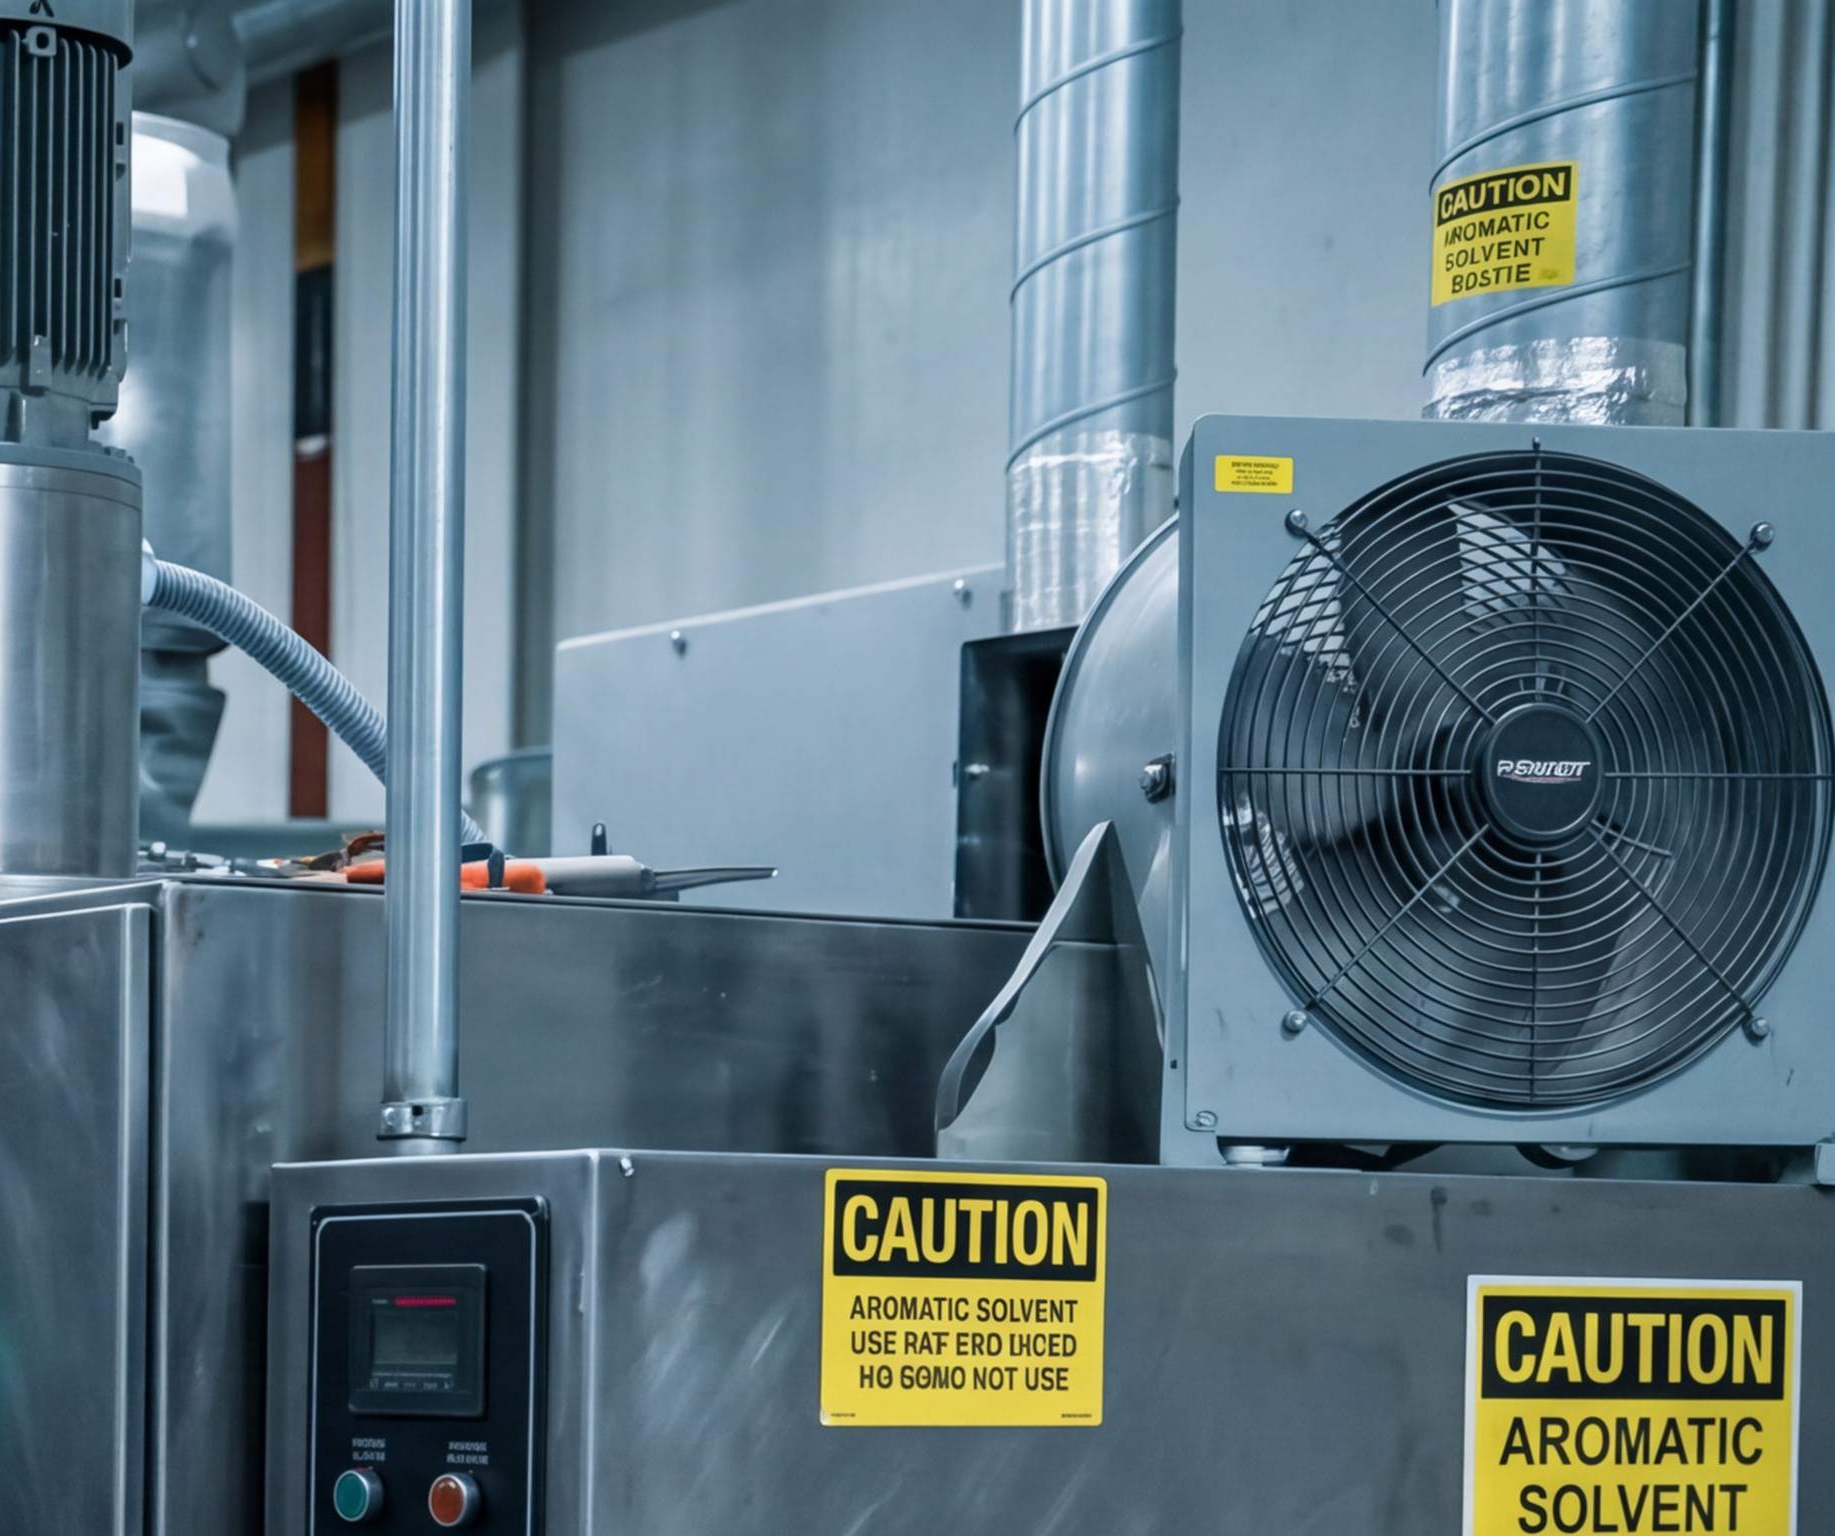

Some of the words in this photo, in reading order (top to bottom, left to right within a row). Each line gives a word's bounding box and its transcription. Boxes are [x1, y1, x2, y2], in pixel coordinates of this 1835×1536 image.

[1440, 172, 1566, 221] CAUTION
[841, 1194, 1089, 1266] CAUTION
[849, 1295, 970, 1322] AROMATIC
[976, 1297, 1079, 1323] SOLVENT
[851, 1330, 898, 1356] USE
[1494, 1310, 1774, 1385] CAUTION
[972, 1366, 1019, 1391] NOT
[1024, 1367, 1070, 1392] USE
[1498, 1416, 1764, 1466] AROMATIC
[1517, 1484, 1749, 1534] SOLVENT
